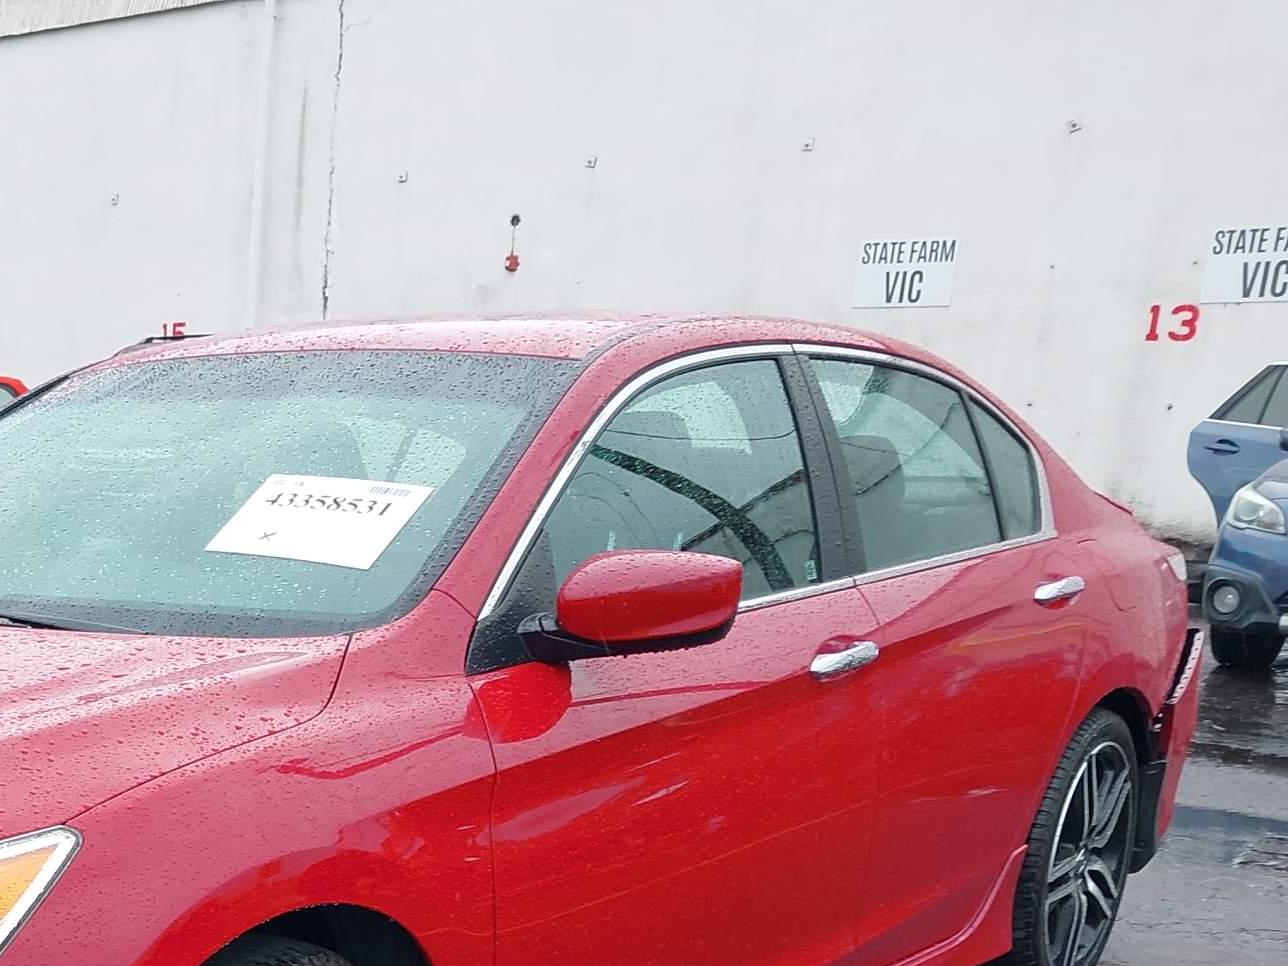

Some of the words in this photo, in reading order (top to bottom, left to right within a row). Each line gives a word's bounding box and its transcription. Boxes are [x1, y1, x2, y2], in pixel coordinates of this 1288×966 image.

[861, 241, 907, 265] STATE
[909, 239, 957, 264] FARM
[1212, 227, 1271, 255] STATE
[884, 270, 924, 304] VIC
[1241, 260, 1288, 299] VIC
[1145, 304, 1200, 341] 13
[264, 492, 393, 517] 43358531
